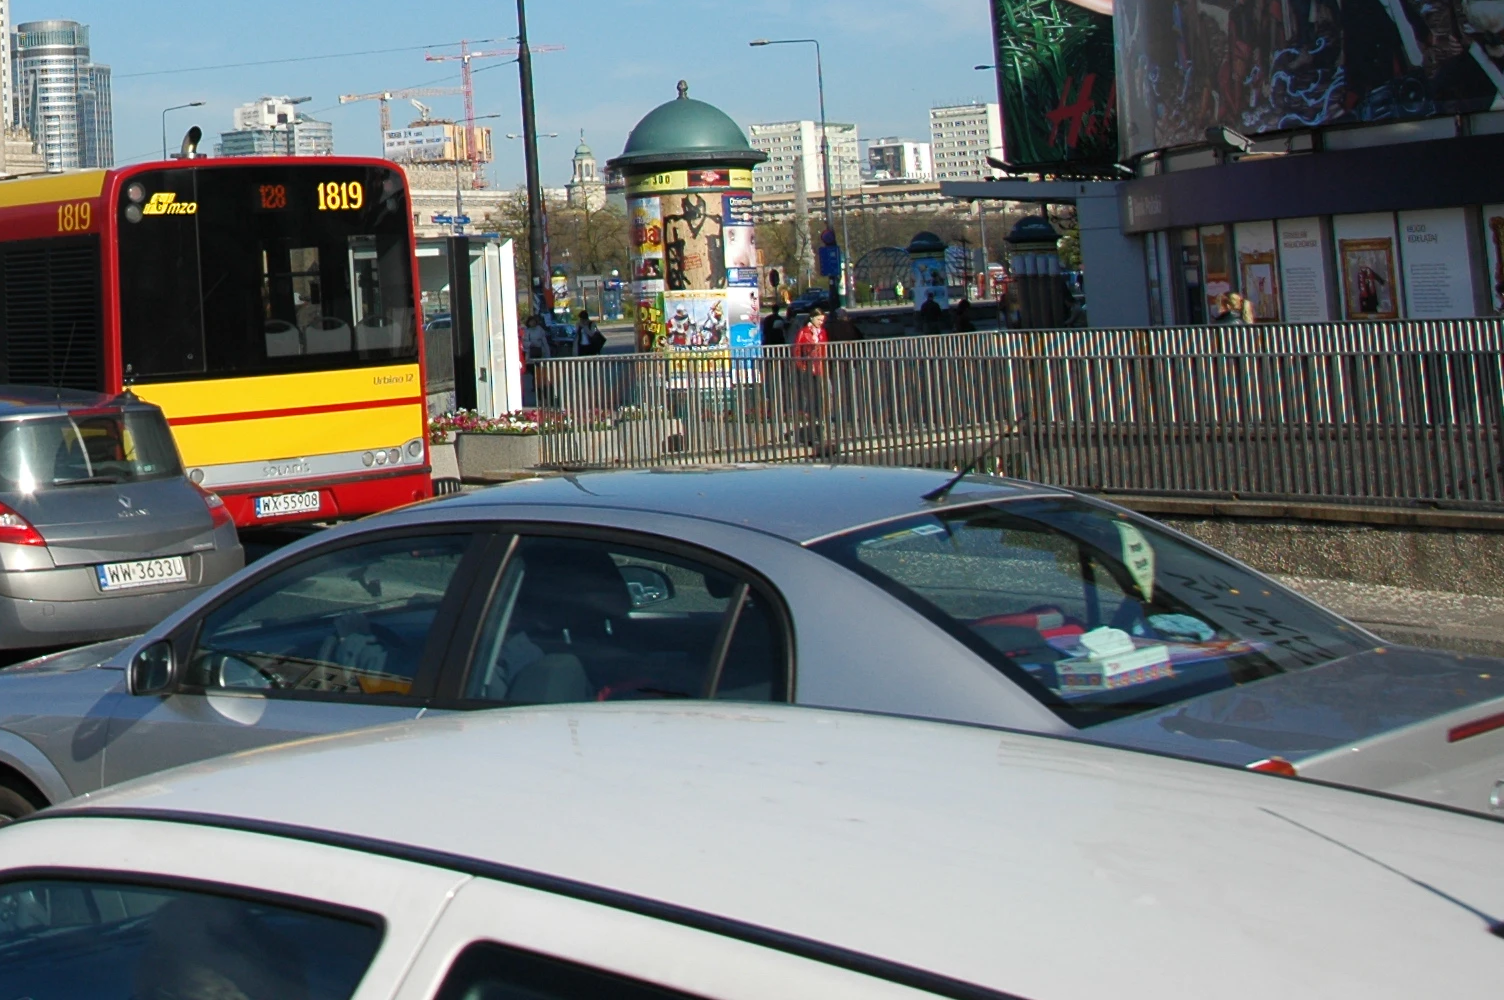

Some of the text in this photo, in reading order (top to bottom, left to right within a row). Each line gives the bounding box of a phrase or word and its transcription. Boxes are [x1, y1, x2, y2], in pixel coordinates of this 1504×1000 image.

[258, 184, 287, 209] 128
[316, 181, 363, 210] 1819
[57, 201, 92, 232] 1819
[373, 373, 414, 385] Urbino 12
[262, 462, 312, 476] SOLARIS
[262, 492, 318, 511] WX 55908
[107, 558, 184, 583] WW 3633U
